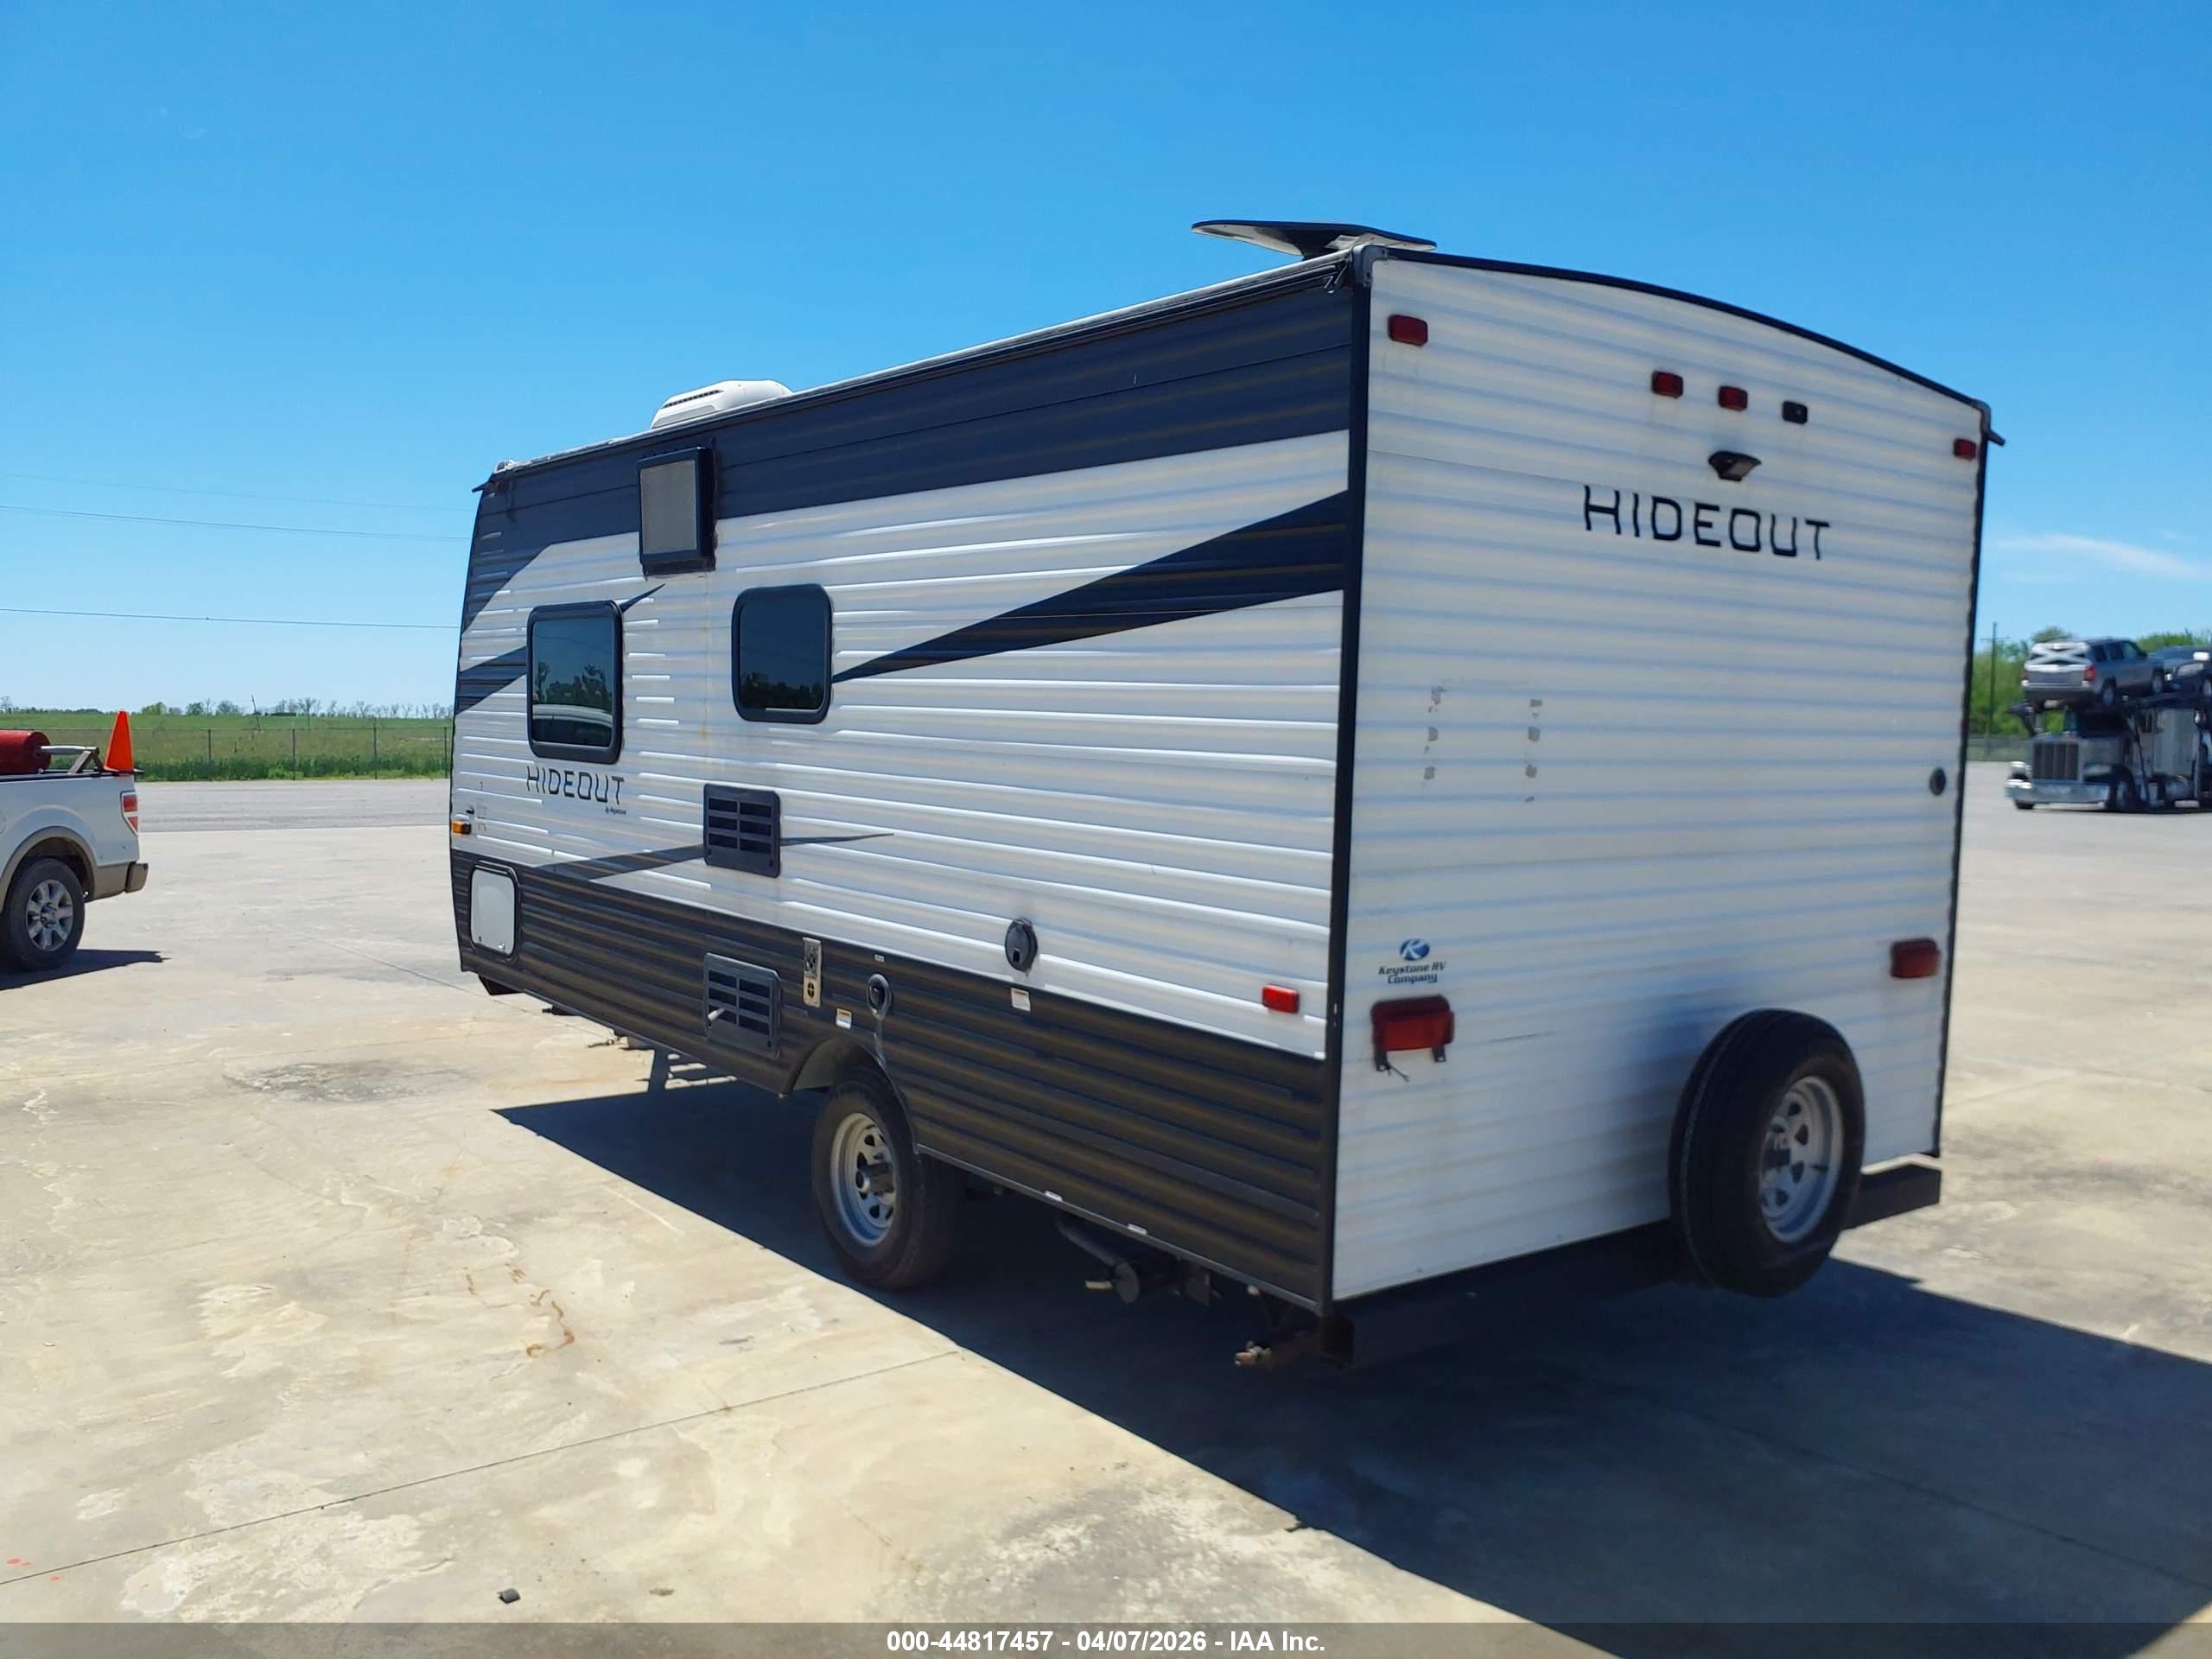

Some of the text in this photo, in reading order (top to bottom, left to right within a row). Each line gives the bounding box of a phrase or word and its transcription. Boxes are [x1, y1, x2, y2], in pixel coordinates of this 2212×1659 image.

[1583, 485, 1831, 561] HIDEOUT
[526, 766, 625, 805] HIDEOUT
[1378, 961, 1446, 976] Keystone RV
[1388, 974, 1438, 984] Company
